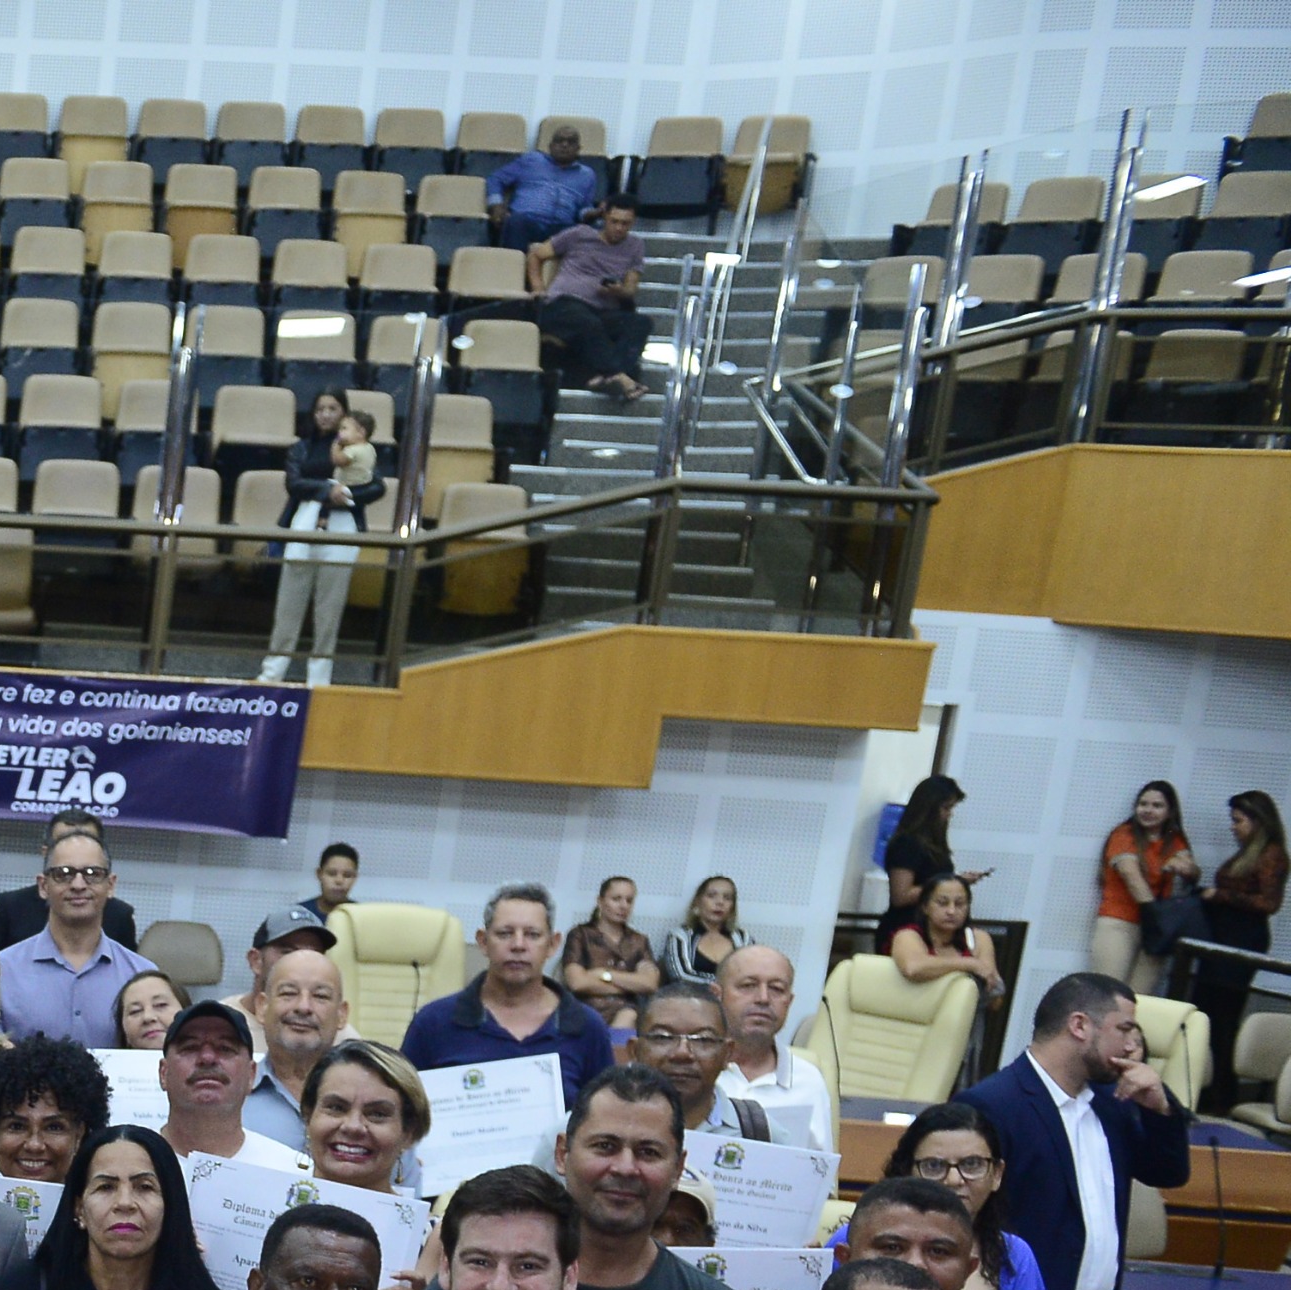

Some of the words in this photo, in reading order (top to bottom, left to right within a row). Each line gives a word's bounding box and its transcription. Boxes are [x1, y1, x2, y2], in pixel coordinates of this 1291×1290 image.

[22, 684, 56, 704] fez
[59, 690, 75, 705] e
[79, 690, 181, 711] continua
[185, 692, 277, 717] fazendo
[281, 701, 299, 718] a
[8, 715, 57, 735] vida
[61, 717, 104, 738] dos
[107, 720, 252, 745] goianienses!
[14, 767, 127, 806] LEÃO
